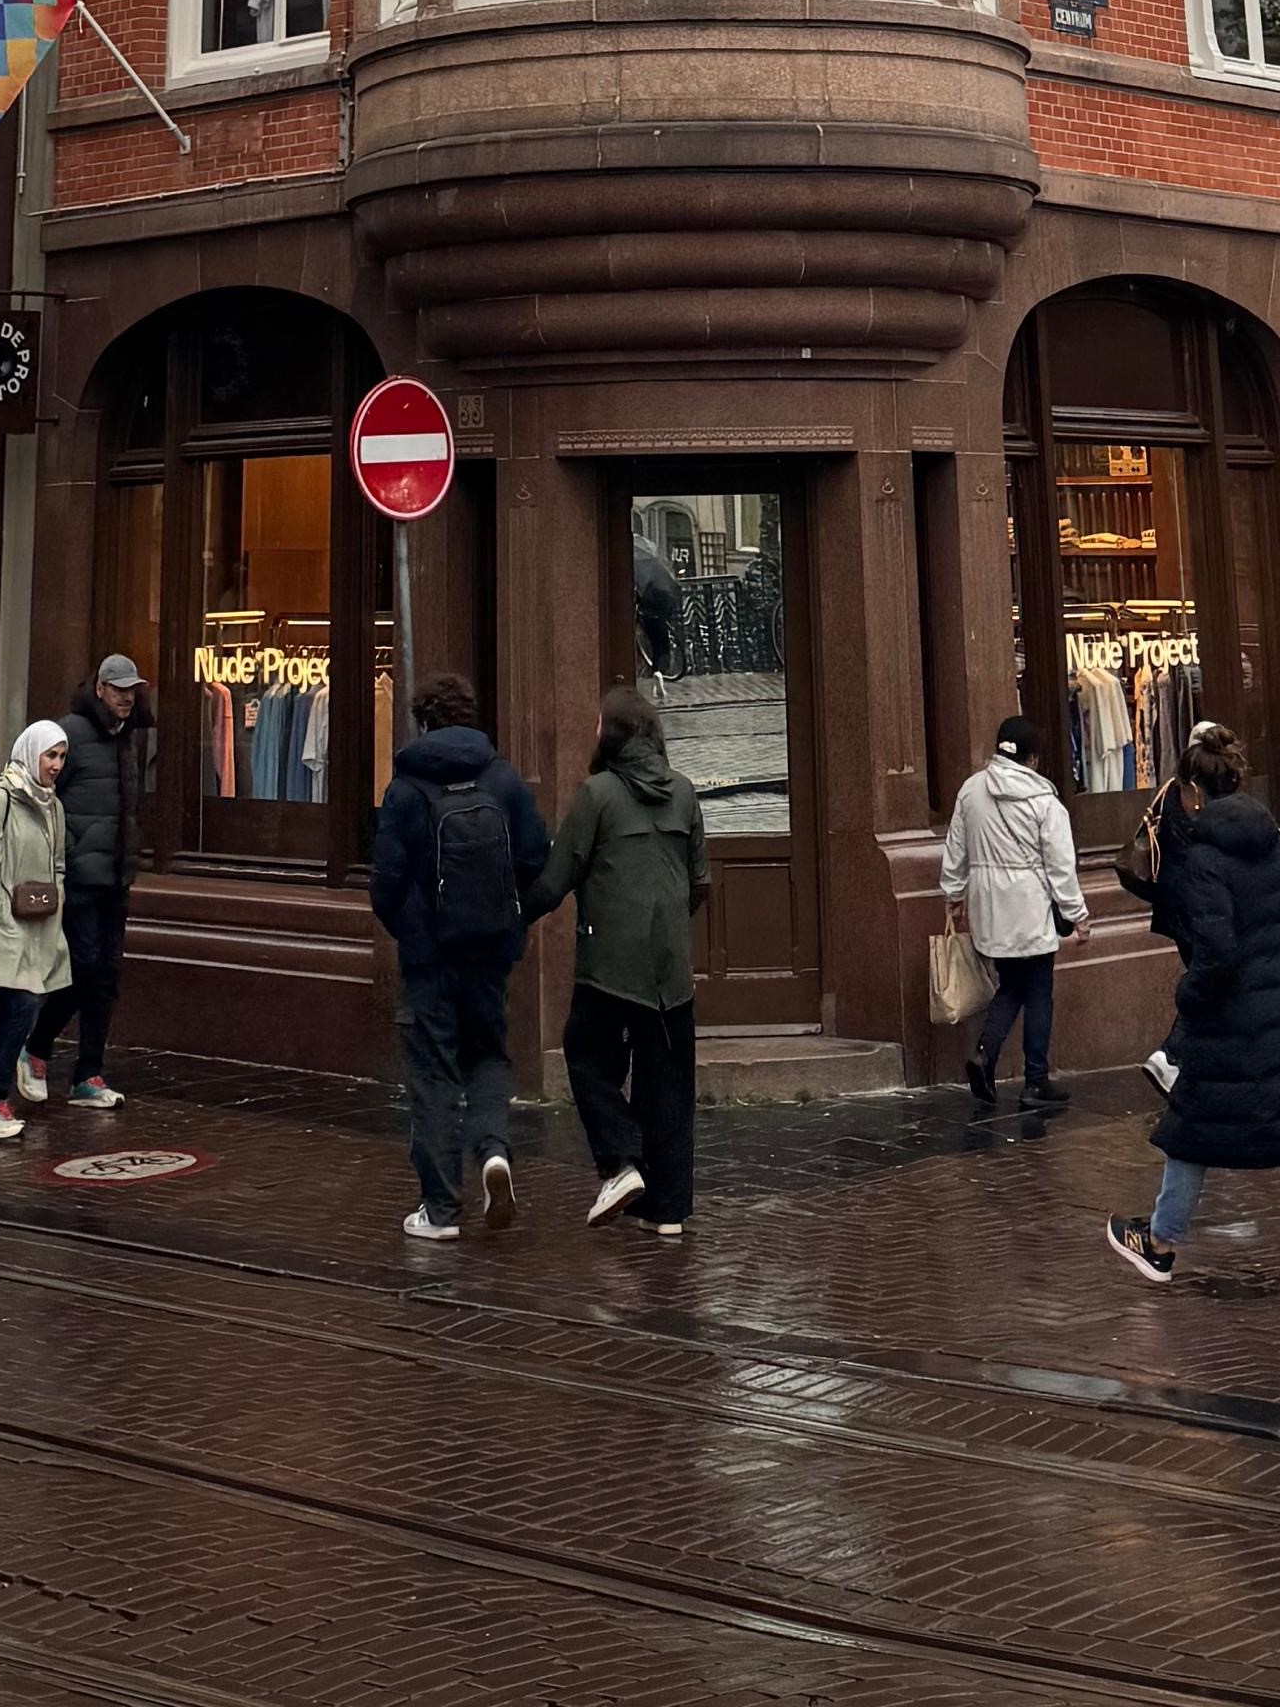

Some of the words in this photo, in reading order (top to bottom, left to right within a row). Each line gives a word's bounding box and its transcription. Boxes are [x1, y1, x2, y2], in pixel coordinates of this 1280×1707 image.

[1055, 7, 1092, 30] CENTRUM
[194, 647, 256, 685] Nude
[262, 647, 330, 695] Projec
[1065, 632, 1123, 670] Nude
[1128, 631, 1201, 674] Project
